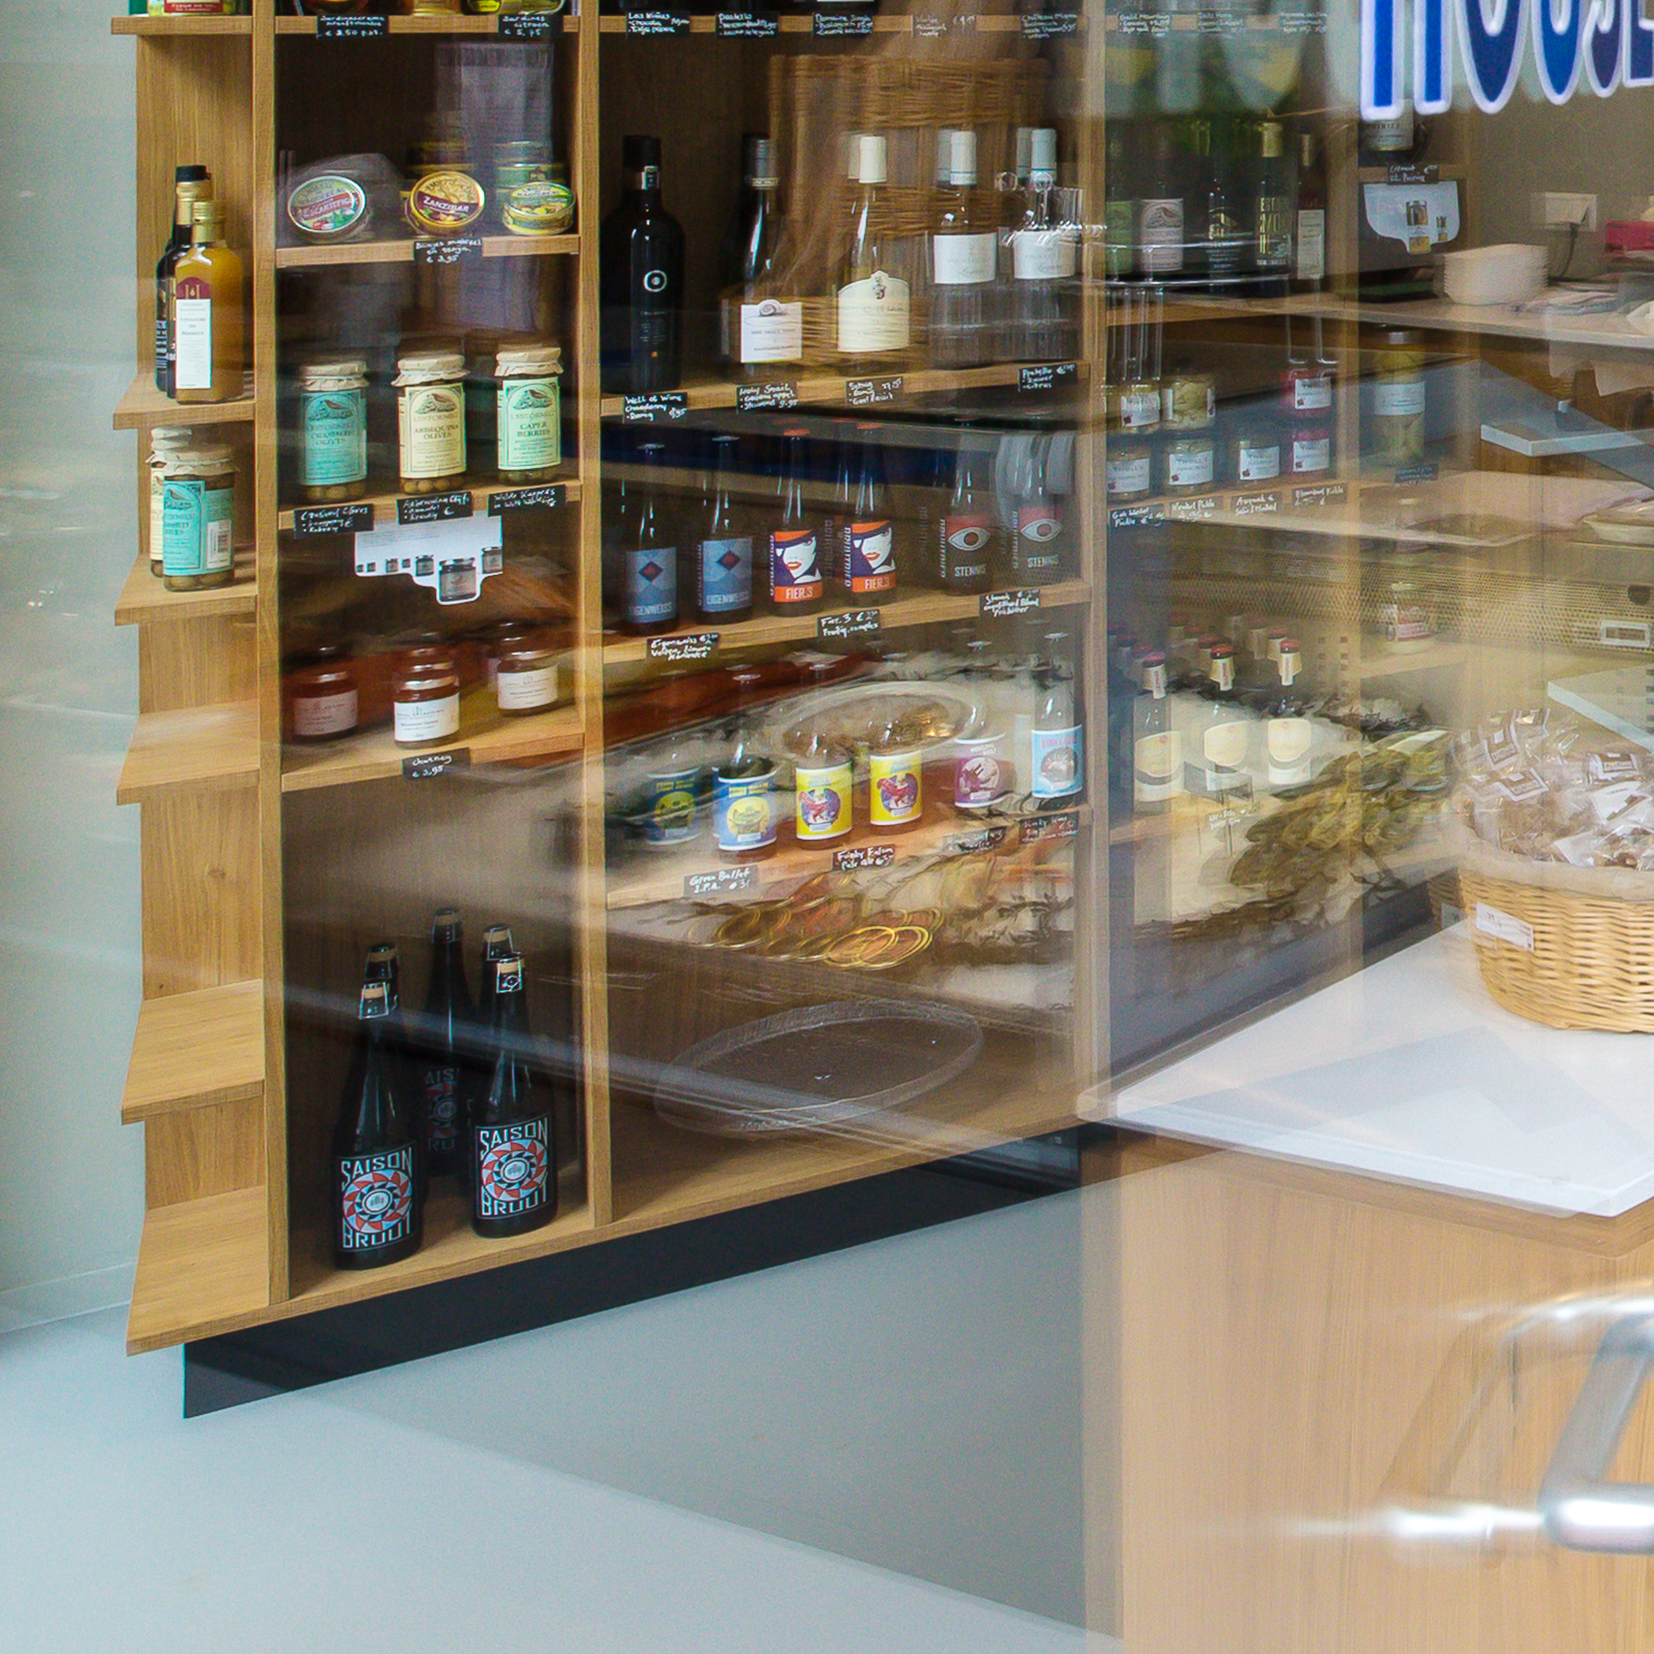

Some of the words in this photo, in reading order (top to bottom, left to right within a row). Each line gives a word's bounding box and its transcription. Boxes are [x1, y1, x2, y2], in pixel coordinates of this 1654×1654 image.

[423, 195, 471, 214] ZANZIBAR
[413, 423, 459, 434] ARBEQUINA
[516, 428, 551, 438] BERRIES
[519, 421, 548, 431] CAPER
[422, 430, 453, 440] OLIVES
[689, 874, 717, 886] Green
[480, 1117, 549, 1157] SAISON
[341, 1146, 413, 1192] SAISON
[481, 1180, 548, 1217] BRUUT
[342, 1203, 412, 1249] BRUUT
